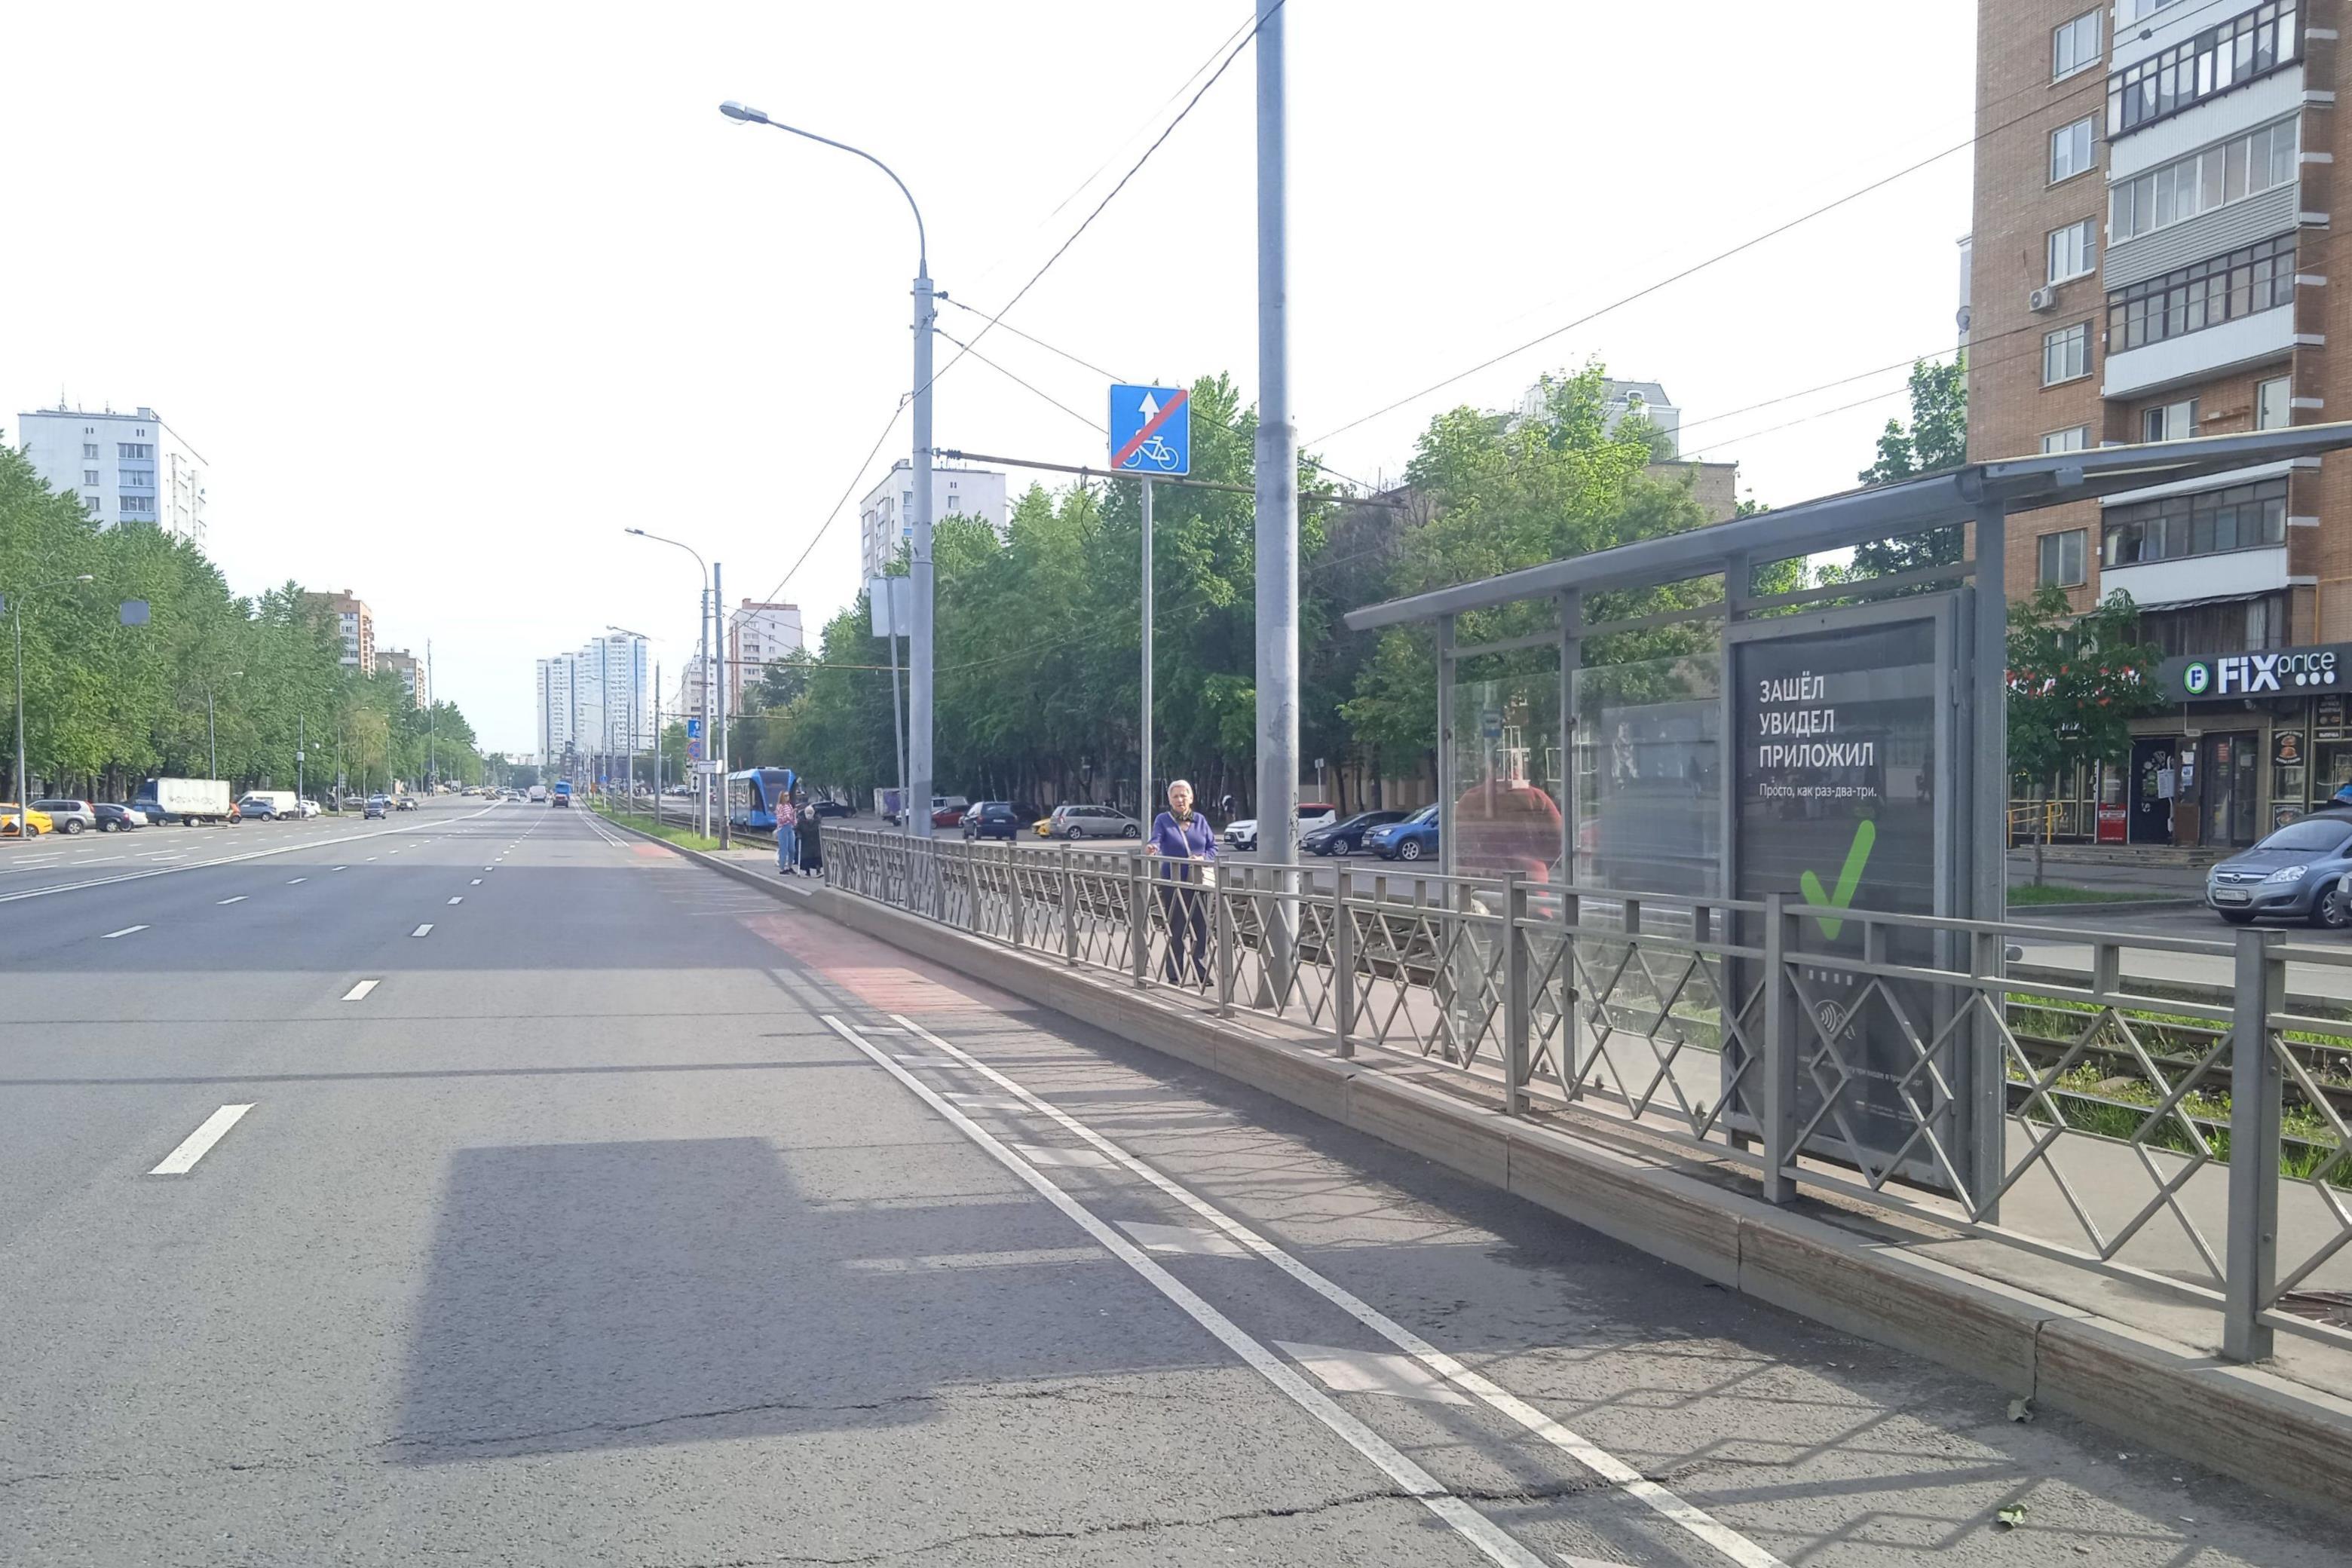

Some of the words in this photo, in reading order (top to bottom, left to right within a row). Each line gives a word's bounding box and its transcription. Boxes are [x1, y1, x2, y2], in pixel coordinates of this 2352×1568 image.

[2277, 652, 2335, 678] price
[1759, 671, 1824, 703] ЗАШЁЛ
[1759, 709, 1835, 738] УВИДЕЛ
[1759, 743, 1874, 768] ПРИЛОЖИЛ
[1759, 783, 1796, 798] Просто,
[1797, 786, 1814, 797] как
[1815, 786, 1878, 800] раз-два-три.
